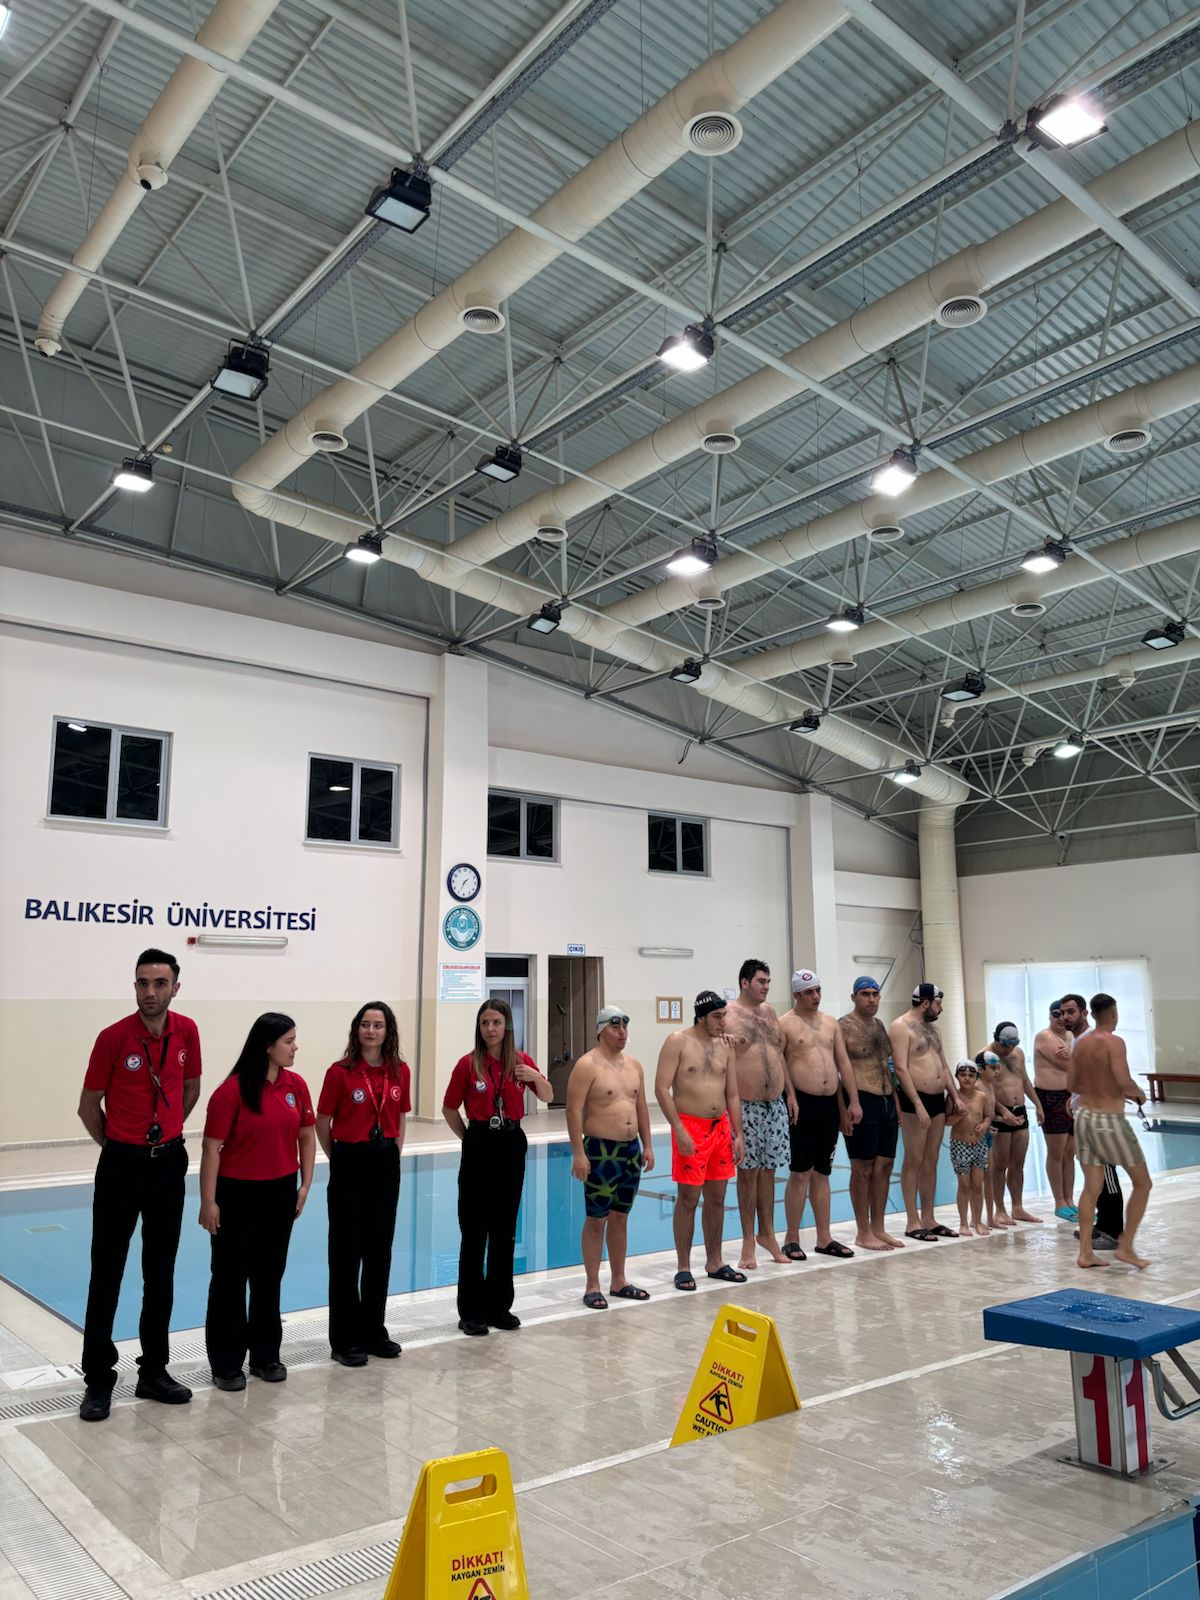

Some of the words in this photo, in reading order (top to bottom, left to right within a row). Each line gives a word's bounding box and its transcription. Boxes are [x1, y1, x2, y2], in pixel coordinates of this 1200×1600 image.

[25, 898, 154, 925] BALIKESİR
[167, 901, 316, 931] ÜNİVERSİTESİ
[711, 1361, 744, 1383] DİKKAT!
[1082, 1354, 1112, 1467] 1
[1125, 1358, 1149, 1476] 1
[451, 1569, 481, 1582] KAYGAN
[483, 1564, 505, 1576] ZEMİN
[452, 1550, 503, 1571] DİKKAT!
